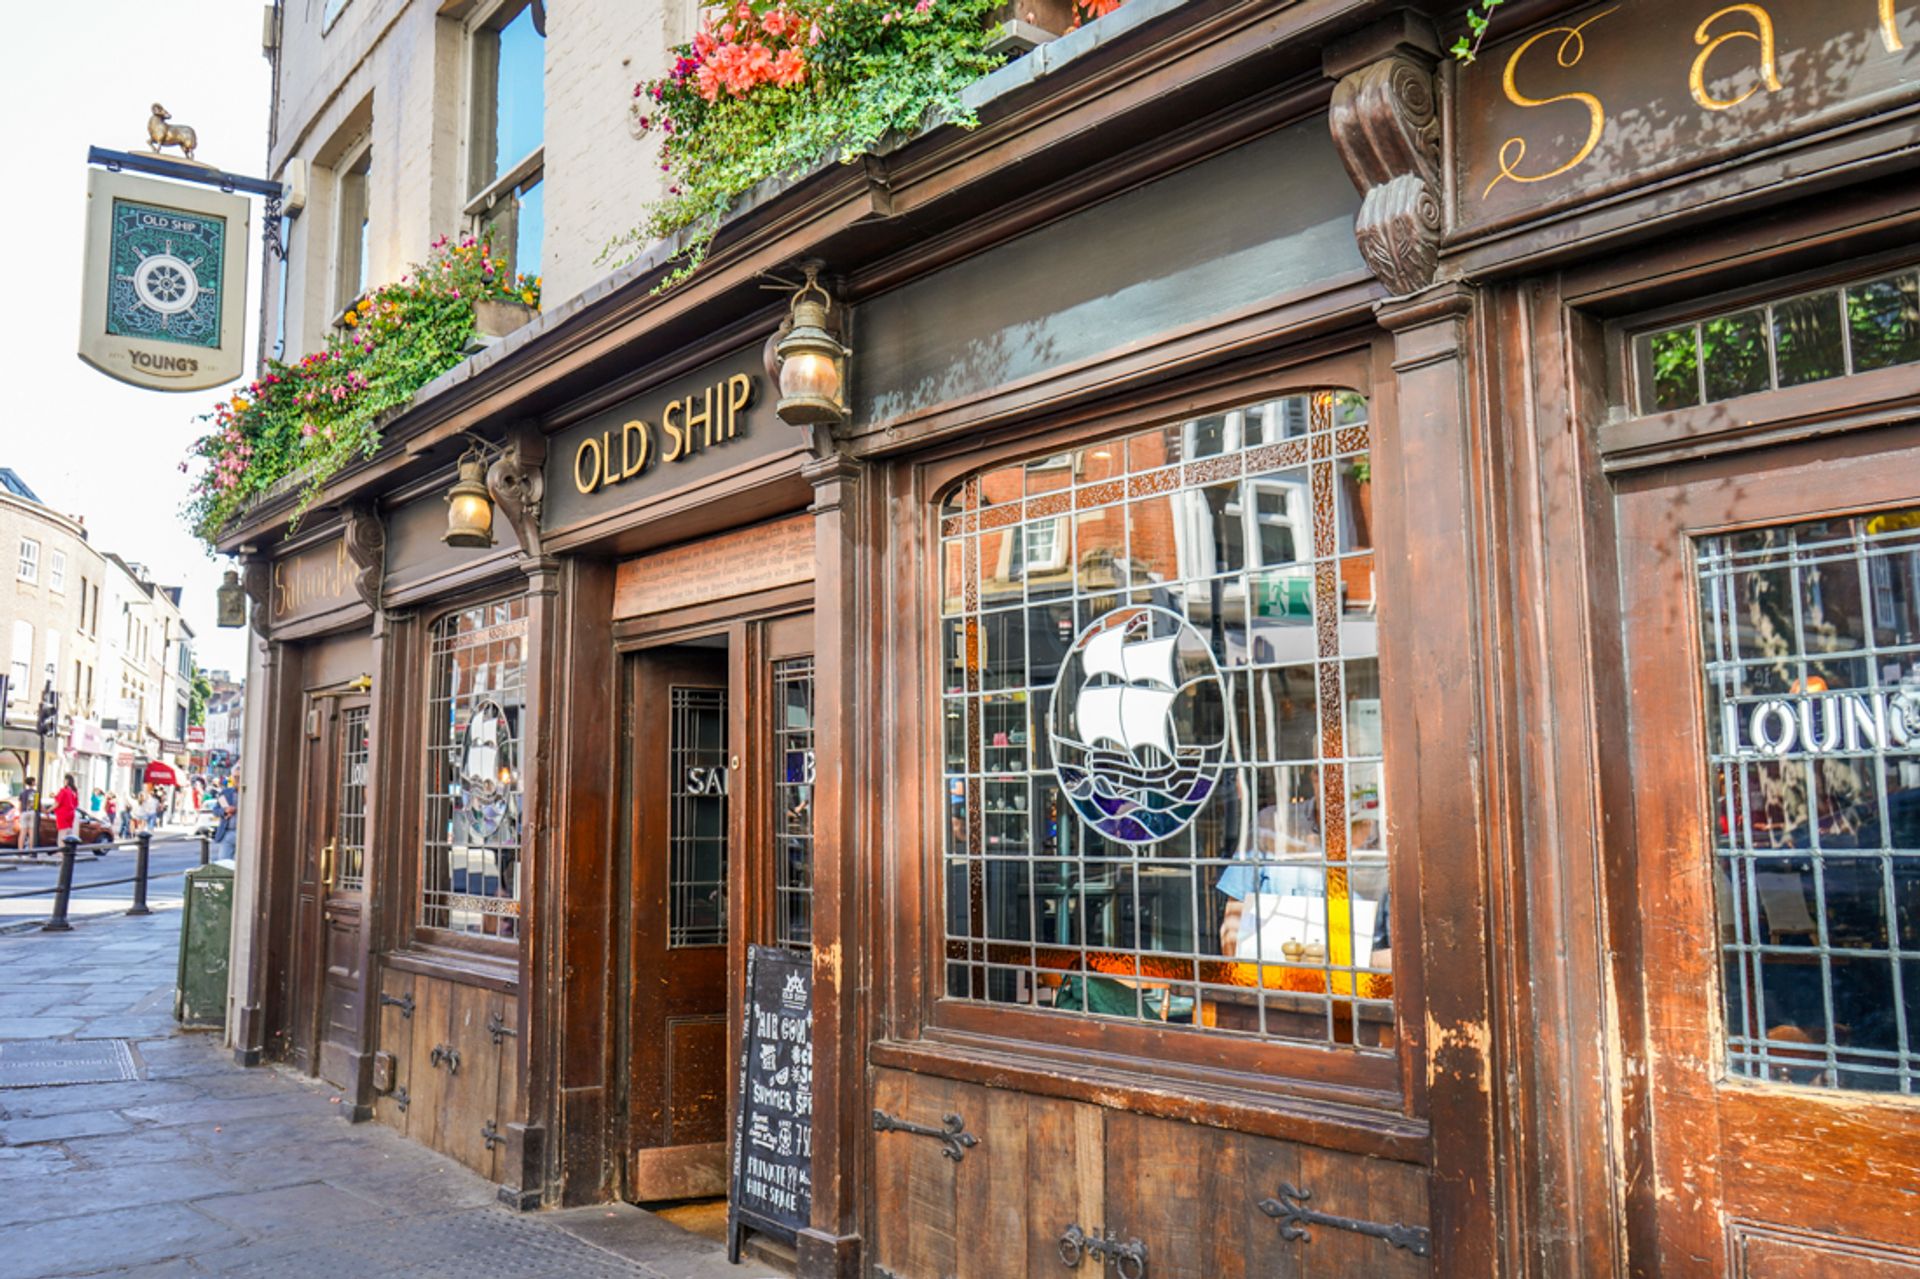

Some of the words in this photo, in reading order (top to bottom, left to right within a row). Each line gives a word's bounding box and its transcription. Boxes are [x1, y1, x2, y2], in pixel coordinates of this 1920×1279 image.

[1482, 0, 1905, 200] Sa
[143, 214, 169, 227] OLD
[171, 219, 197, 231] SHIP
[128, 348, 199, 372] YOUNG'S
[574, 419, 649, 494] OLD
[662, 372, 751, 464] SHIP
[757, 1010, 779, 1040] AIR
[753, 1083, 793, 1112] SUMMER
[747, 1155, 787, 1188] PRIVATE
[746, 1177, 768, 1200] HIRE
[769, 1185, 797, 1212] SPACE
